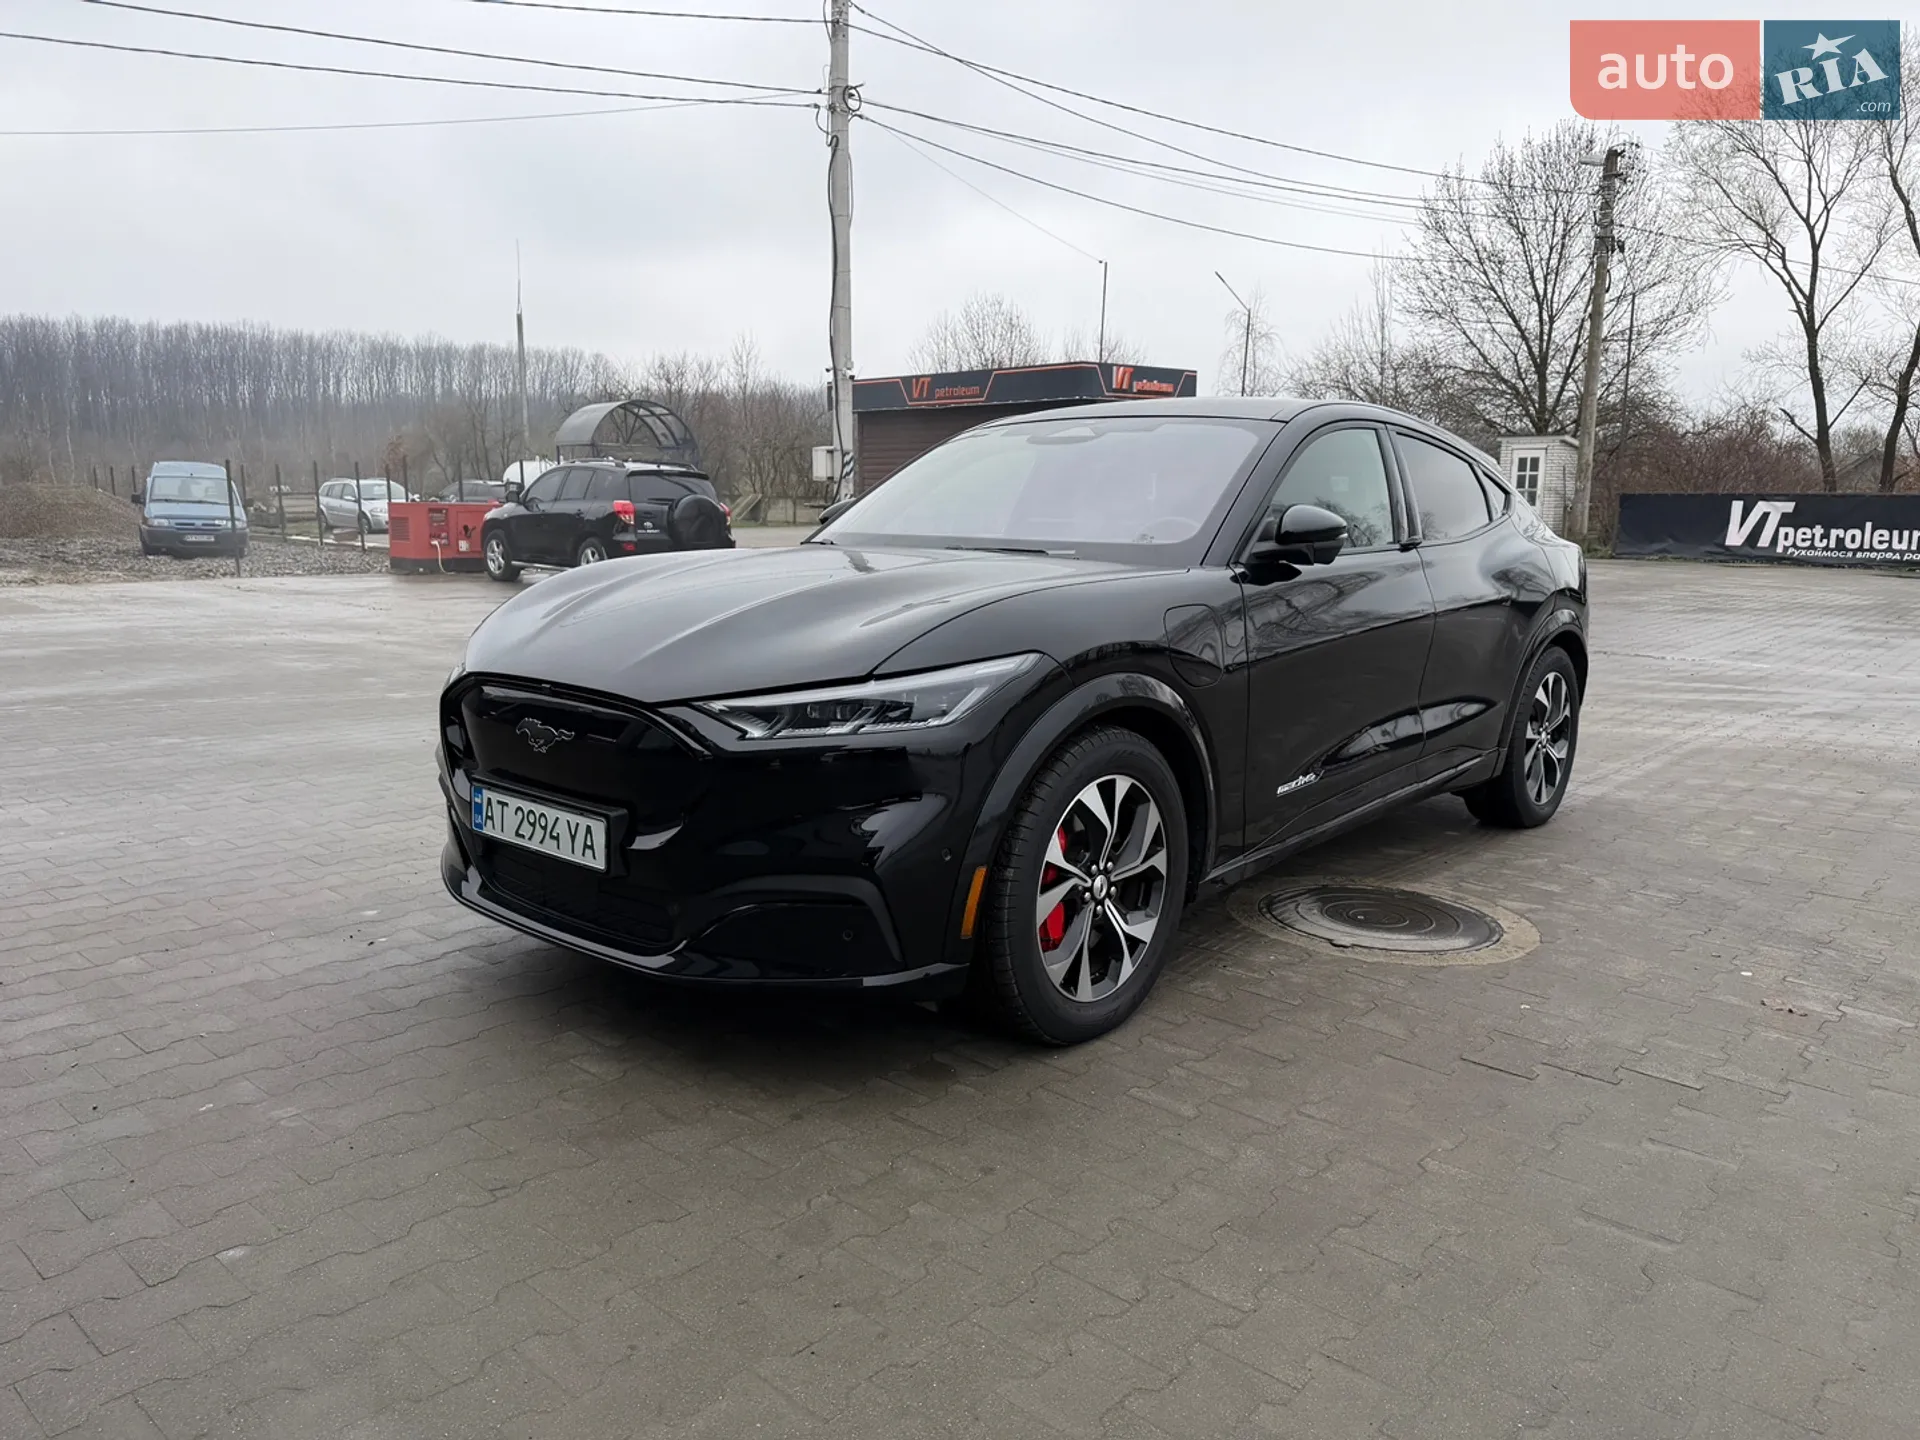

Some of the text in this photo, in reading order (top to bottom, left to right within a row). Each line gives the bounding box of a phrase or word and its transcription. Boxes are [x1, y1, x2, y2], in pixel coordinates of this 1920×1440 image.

[912, 377, 979, 399] VT petroleum
[1112, 366, 1134, 389] VT
[1787, 547, 1852, 558] Рухаймося
[1856, 551, 1900, 561] вперед
[484, 797, 597, 860] AT 2994 YA
